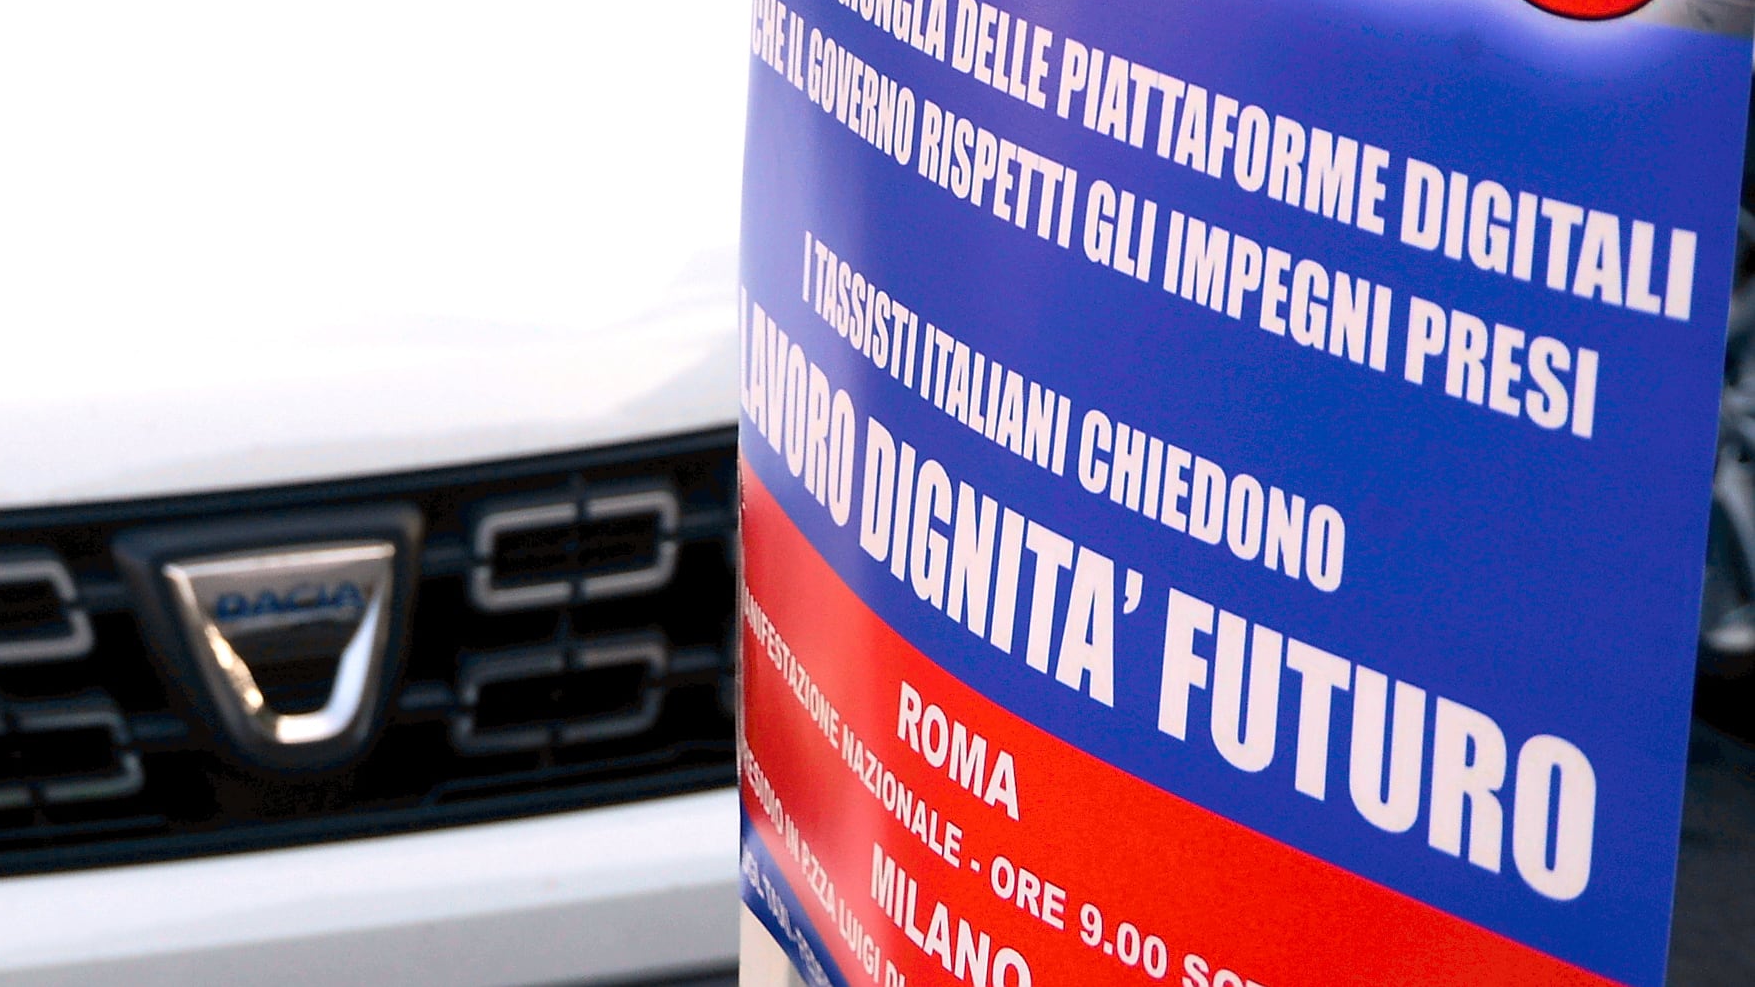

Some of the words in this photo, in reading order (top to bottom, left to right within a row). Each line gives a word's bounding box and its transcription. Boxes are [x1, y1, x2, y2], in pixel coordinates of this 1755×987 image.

[787, 10, 804, 91] IL
[808, 27, 916, 166] GOVERNO
[918, 98, 1077, 249] RISPETTI
[1083, 179, 1156, 283] GLI
[1163, 209, 1392, 374] IMPEGNI
[1404, 294, 1600, 440] PRESI
[1056, 38, 1390, 236] PIATTAFORME
[1400, 156, 1698, 321] DIGITALI
[802, 230, 813, 303] I
[813, 238, 918, 389] TASSISTI
[919, 322, 1071, 477] ITALIANI
[1077, 409, 1346, 593] CHIEDONO
[216, 581, 364, 617] DACIA
[740, 284, 855, 527] LAVORO
[1158, 586, 1598, 902] FUTURO
[841, 723, 963, 869] NAZIONALE
[990, 855, 1066, 930] ORE
[1079, 902, 1168, 979] 9.00
[898, 680, 1020, 821] ROMA
[839, 898, 881, 984] LUIGI
[870, 843, 1032, 987] MILANO
